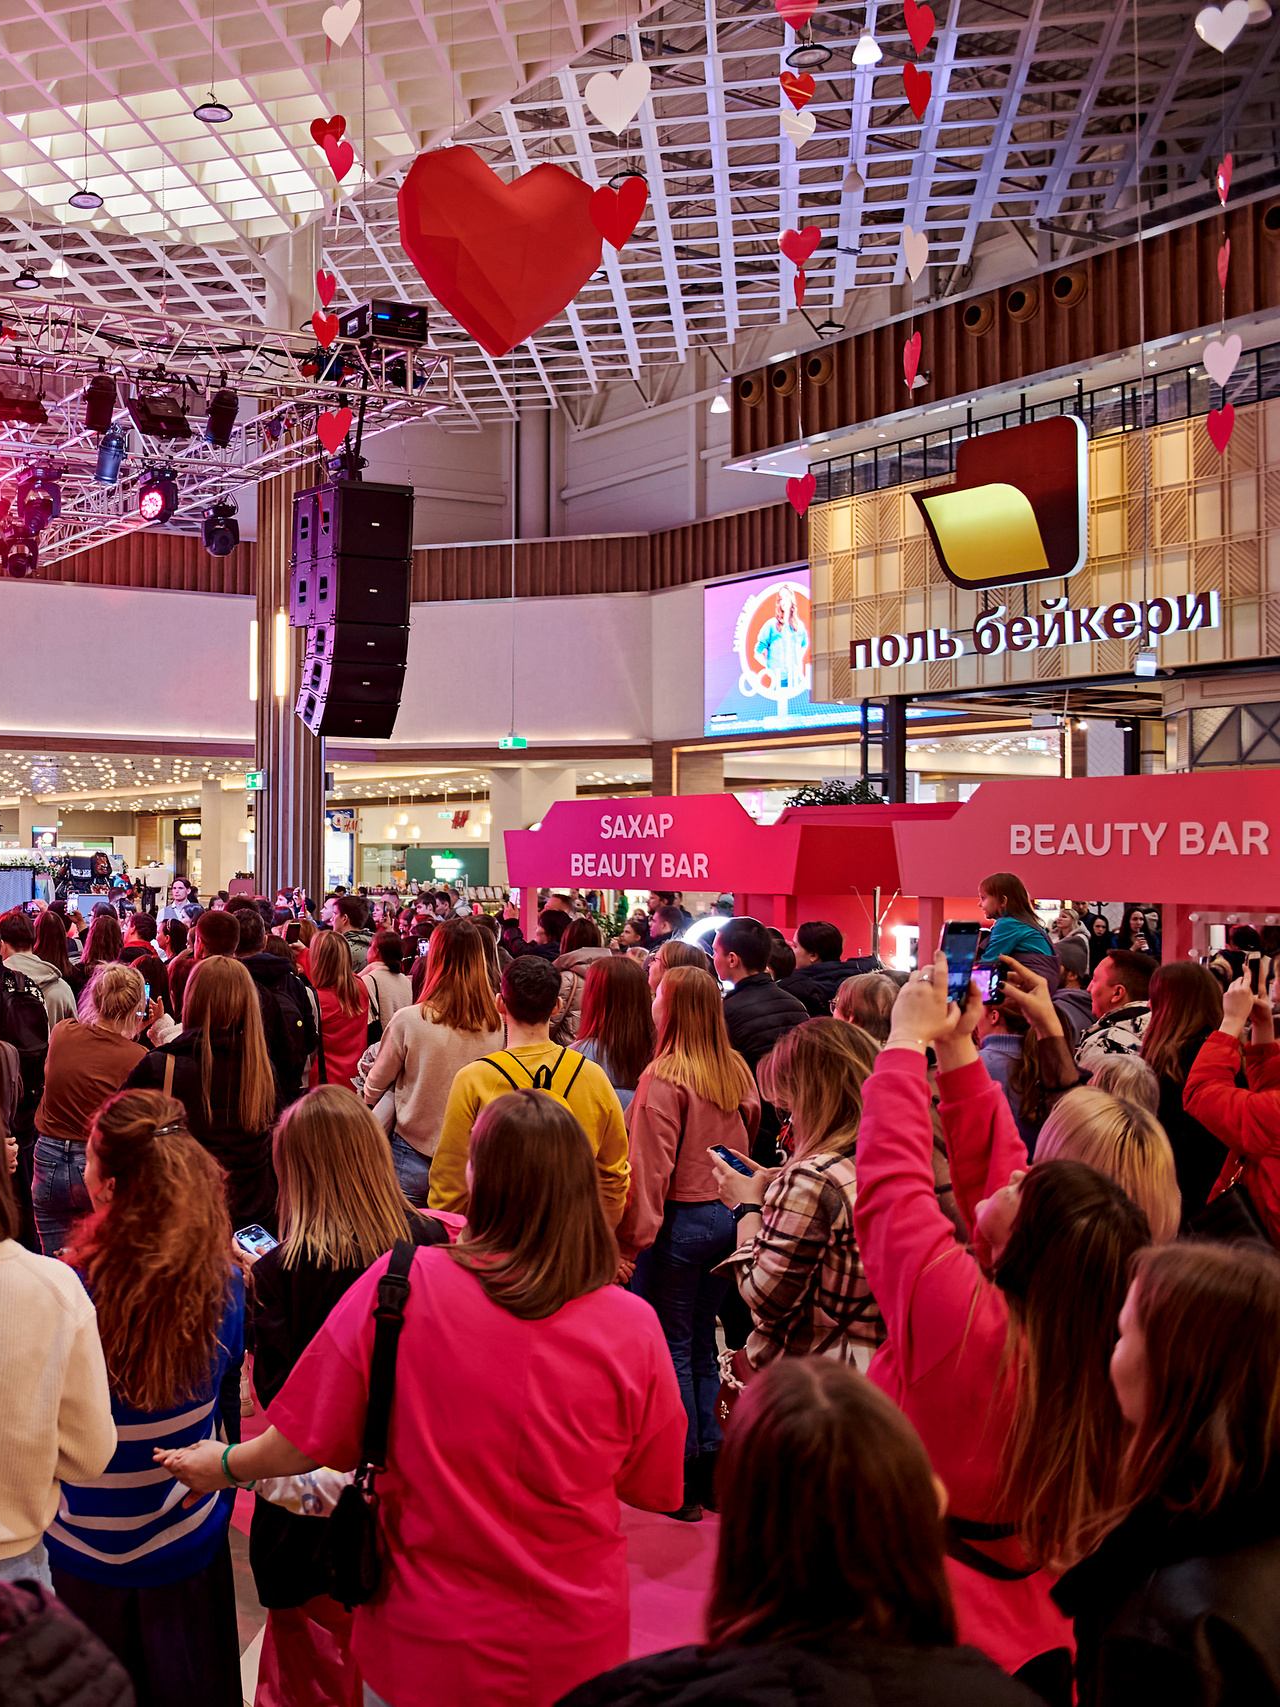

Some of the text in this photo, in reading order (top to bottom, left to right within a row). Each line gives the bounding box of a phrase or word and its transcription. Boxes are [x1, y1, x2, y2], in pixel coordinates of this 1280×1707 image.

[850, 589, 1221, 671] поль бейкери
[1010, 820, 1270, 857] BEAUTY BAR
[570, 853, 709, 878] BEAUTY BAR
